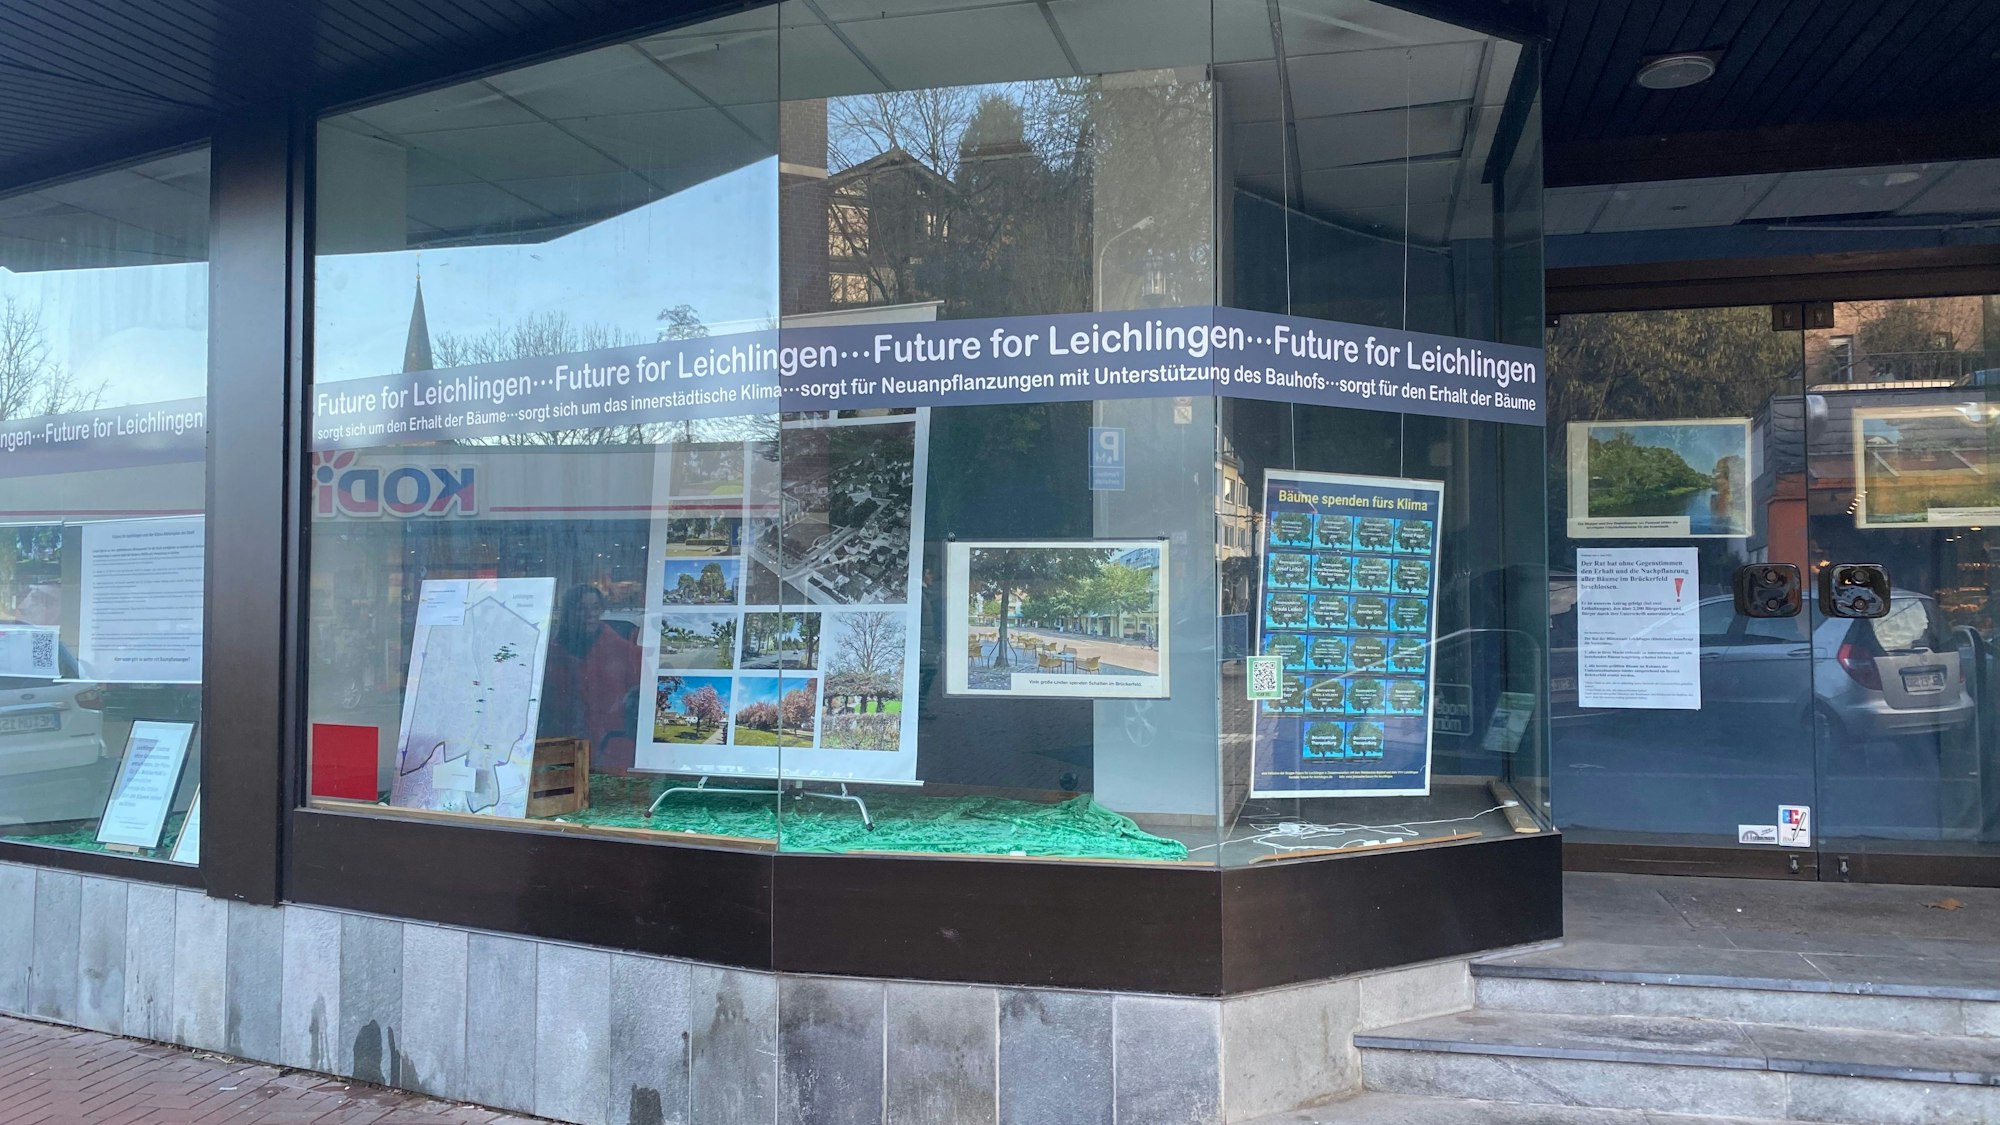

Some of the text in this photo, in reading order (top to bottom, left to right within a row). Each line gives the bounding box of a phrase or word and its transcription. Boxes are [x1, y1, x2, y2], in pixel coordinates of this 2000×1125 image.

[381, 386, 408, 409] for
[636, 356, 671, 383] for
[990, 328, 1039, 358] for
[1365, 336, 1400, 367] for
[1408, 341, 1536, 387] Leichlingen
[93, 417, 114, 438] for
[117, 410, 203, 435] Leichlingen
[318, 424, 343, 441] sorgt
[345, 422, 366, 437] sich
[369, 422, 384, 435] um
[387, 420, 406, 433] den
[410, 415, 442, 431] Erhalt
[444, 413, 463, 427] der
[553, 401, 578, 417] sich
[582, 402, 601, 414] um
[604, 398, 627, 412] das
[631, 387, 737, 410] innerstädtische
[851, 378, 877, 394] für
[882, 374, 1054, 396] Neuanpflanzungen
[1060, 368, 1090, 387] mit
[1095, 364, 1230, 385] Unterstützung
[1234, 365, 1261, 383] des
[1379, 379, 1398, 397] für
[1402, 383, 1426, 399] den
[1430, 385, 1468, 404] Erhalt
[1471, 390, 1492, 405] der
[1495, 392, 1536, 410] Bäume
[1279, 489, 1427, 511] Bäume spenden fürs Klima
